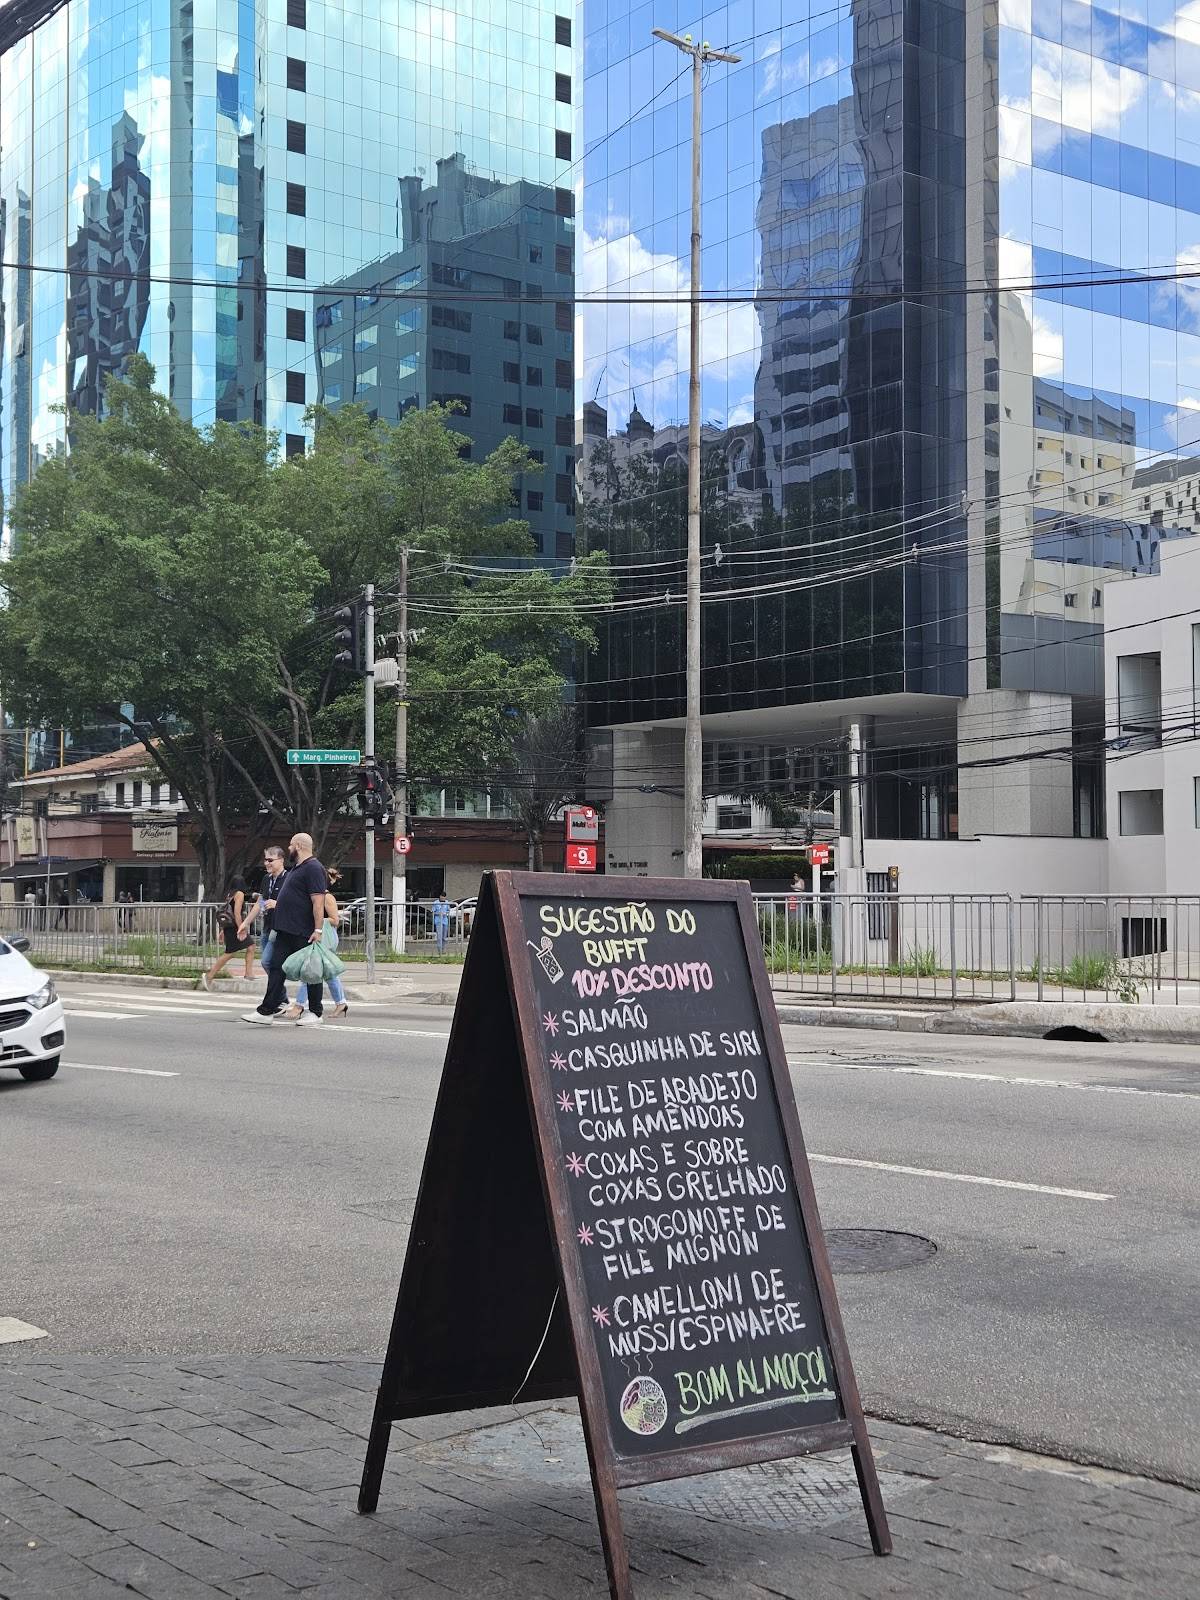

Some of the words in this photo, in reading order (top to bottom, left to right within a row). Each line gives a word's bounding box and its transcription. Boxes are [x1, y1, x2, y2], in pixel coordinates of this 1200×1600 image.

[303, 753, 322, 761] Marq.
[325, 753, 356, 761] Pinheiros
[578, 849, 587, 864] 9
[540, 902, 656, 937] SUGESTÃO
[667, 908, 697, 936] DO
[571, 969, 610, 998] 10%
[612, 962, 714, 996] DESCONTO
[562, 996, 648, 1037] SALMÃO
[567, 1034, 691, 1072] CASQUINHA
[690, 1030, 717, 1057] DE
[719, 1029, 761, 1056] SIRI
[574, 1085, 623, 1116] FILE
[629, 1079, 656, 1106] DE
[661, 1068, 758, 1105] ABADEJO
[579, 1118, 626, 1142] COM
[632, 1103, 744, 1139] AMÊNDOAS
[584, 1145, 659, 1180] COXAS
[661, 1142, 677, 1166] E
[684, 1137, 749, 1169] SOBRE
[588, 1177, 662, 1207] COXAS
[666, 1164, 787, 1202] GRELHADO
[595, 1206, 746, 1250] STROGONOFF
[755, 1204, 787, 1232] DE
[602, 1249, 655, 1281] FILE
[667, 1231, 759, 1270] MIGNON
[613, 1272, 743, 1328] CANELLONI
[751, 1268, 786, 1302] DE
[674, 1363, 735, 1416] BOM
